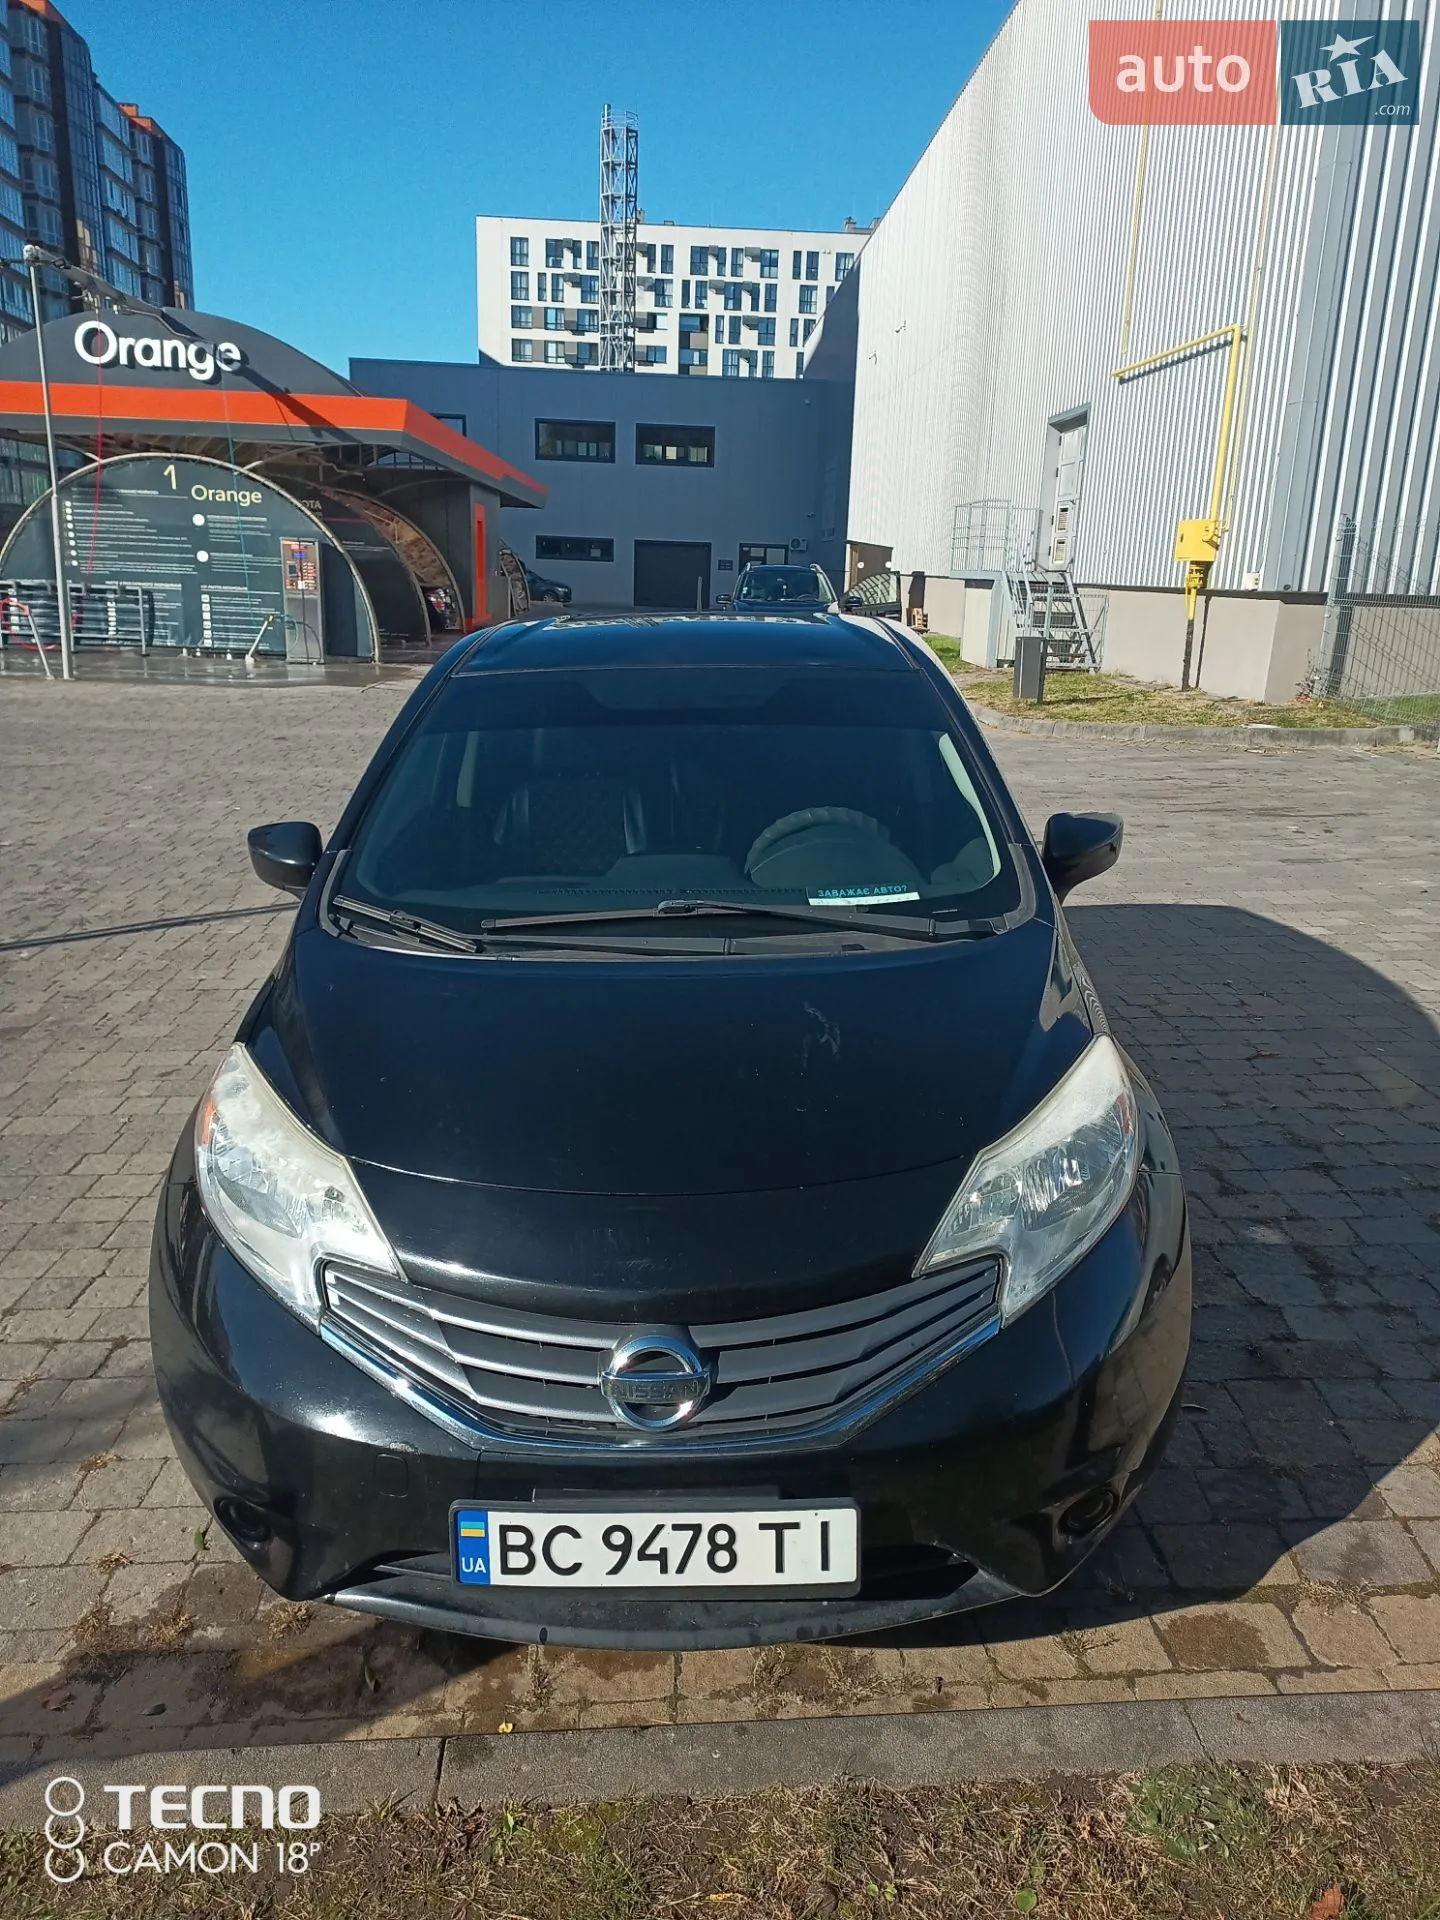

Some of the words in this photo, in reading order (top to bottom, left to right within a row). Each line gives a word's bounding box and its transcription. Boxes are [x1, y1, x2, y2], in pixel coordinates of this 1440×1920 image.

[74, 320, 242, 381] Orange
[163, 465, 177, 490] 1
[191, 484, 262, 507] Orange
[817, 887, 870, 897] ЗАВАЖАЄ
[873, 885, 908, 895] АВТО?
[498, 1523, 583, 1576] BC
[601, 1523, 738, 1576] 9478
[461, 1557, 487, 1573] UA
